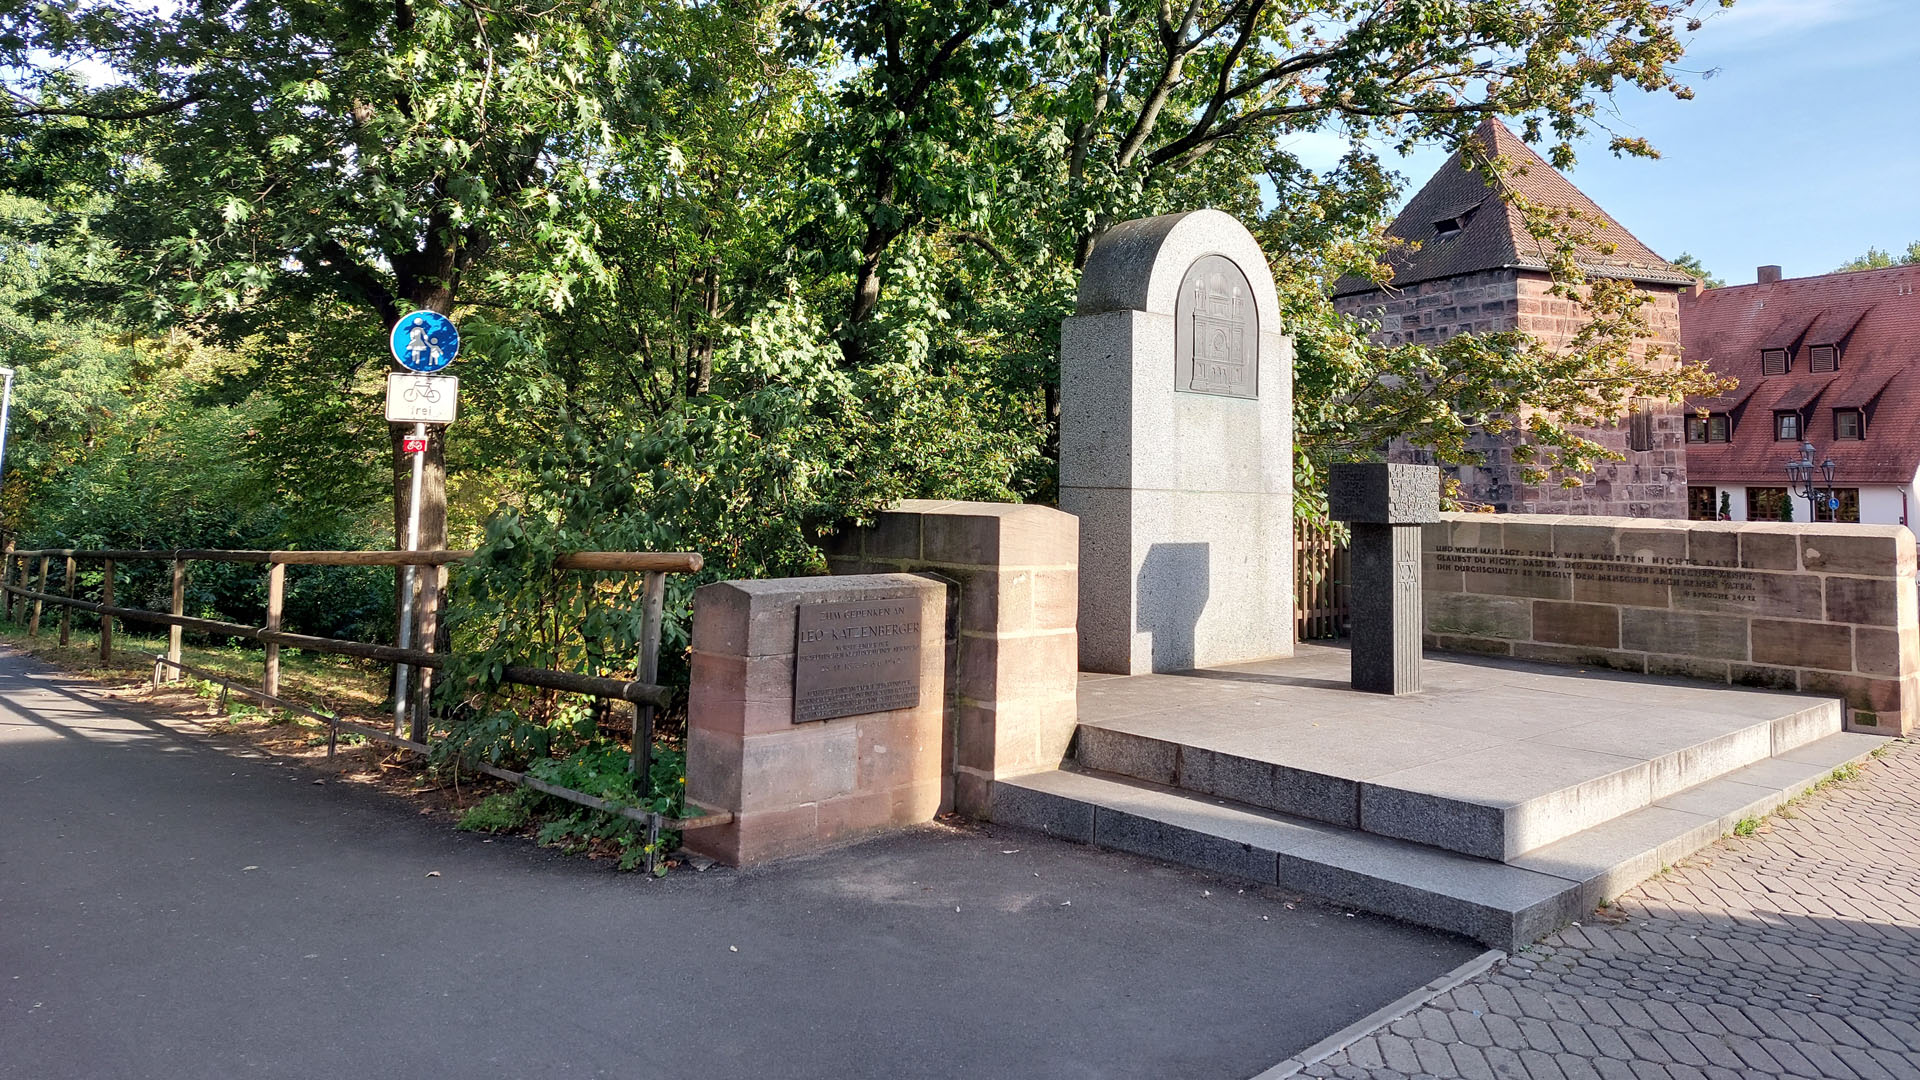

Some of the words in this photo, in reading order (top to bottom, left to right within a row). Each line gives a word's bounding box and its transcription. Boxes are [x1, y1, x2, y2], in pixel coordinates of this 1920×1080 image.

[1436, 554, 1471, 563] GLAUBST
[1475, 556, 1485, 564] DU
[1455, 546, 1478, 554] WENN
[1480, 547, 1497, 555] MAN
[1564, 552, 1584, 560] WIR
[1436, 563, 1451, 571] IHN
[1454, 565, 1518, 575] DURCHSCHAUT?
[1536, 570, 1572, 579] VERGILT
[1576, 572, 1593, 580] DEM
[820, 610, 841, 621] ZUM
[844, 606, 890, 619] GEDENKEN
[894, 606, 905, 615] AN
[801, 628, 824, 643] LEO
[832, 621, 920, 640] KATZENBERGER
